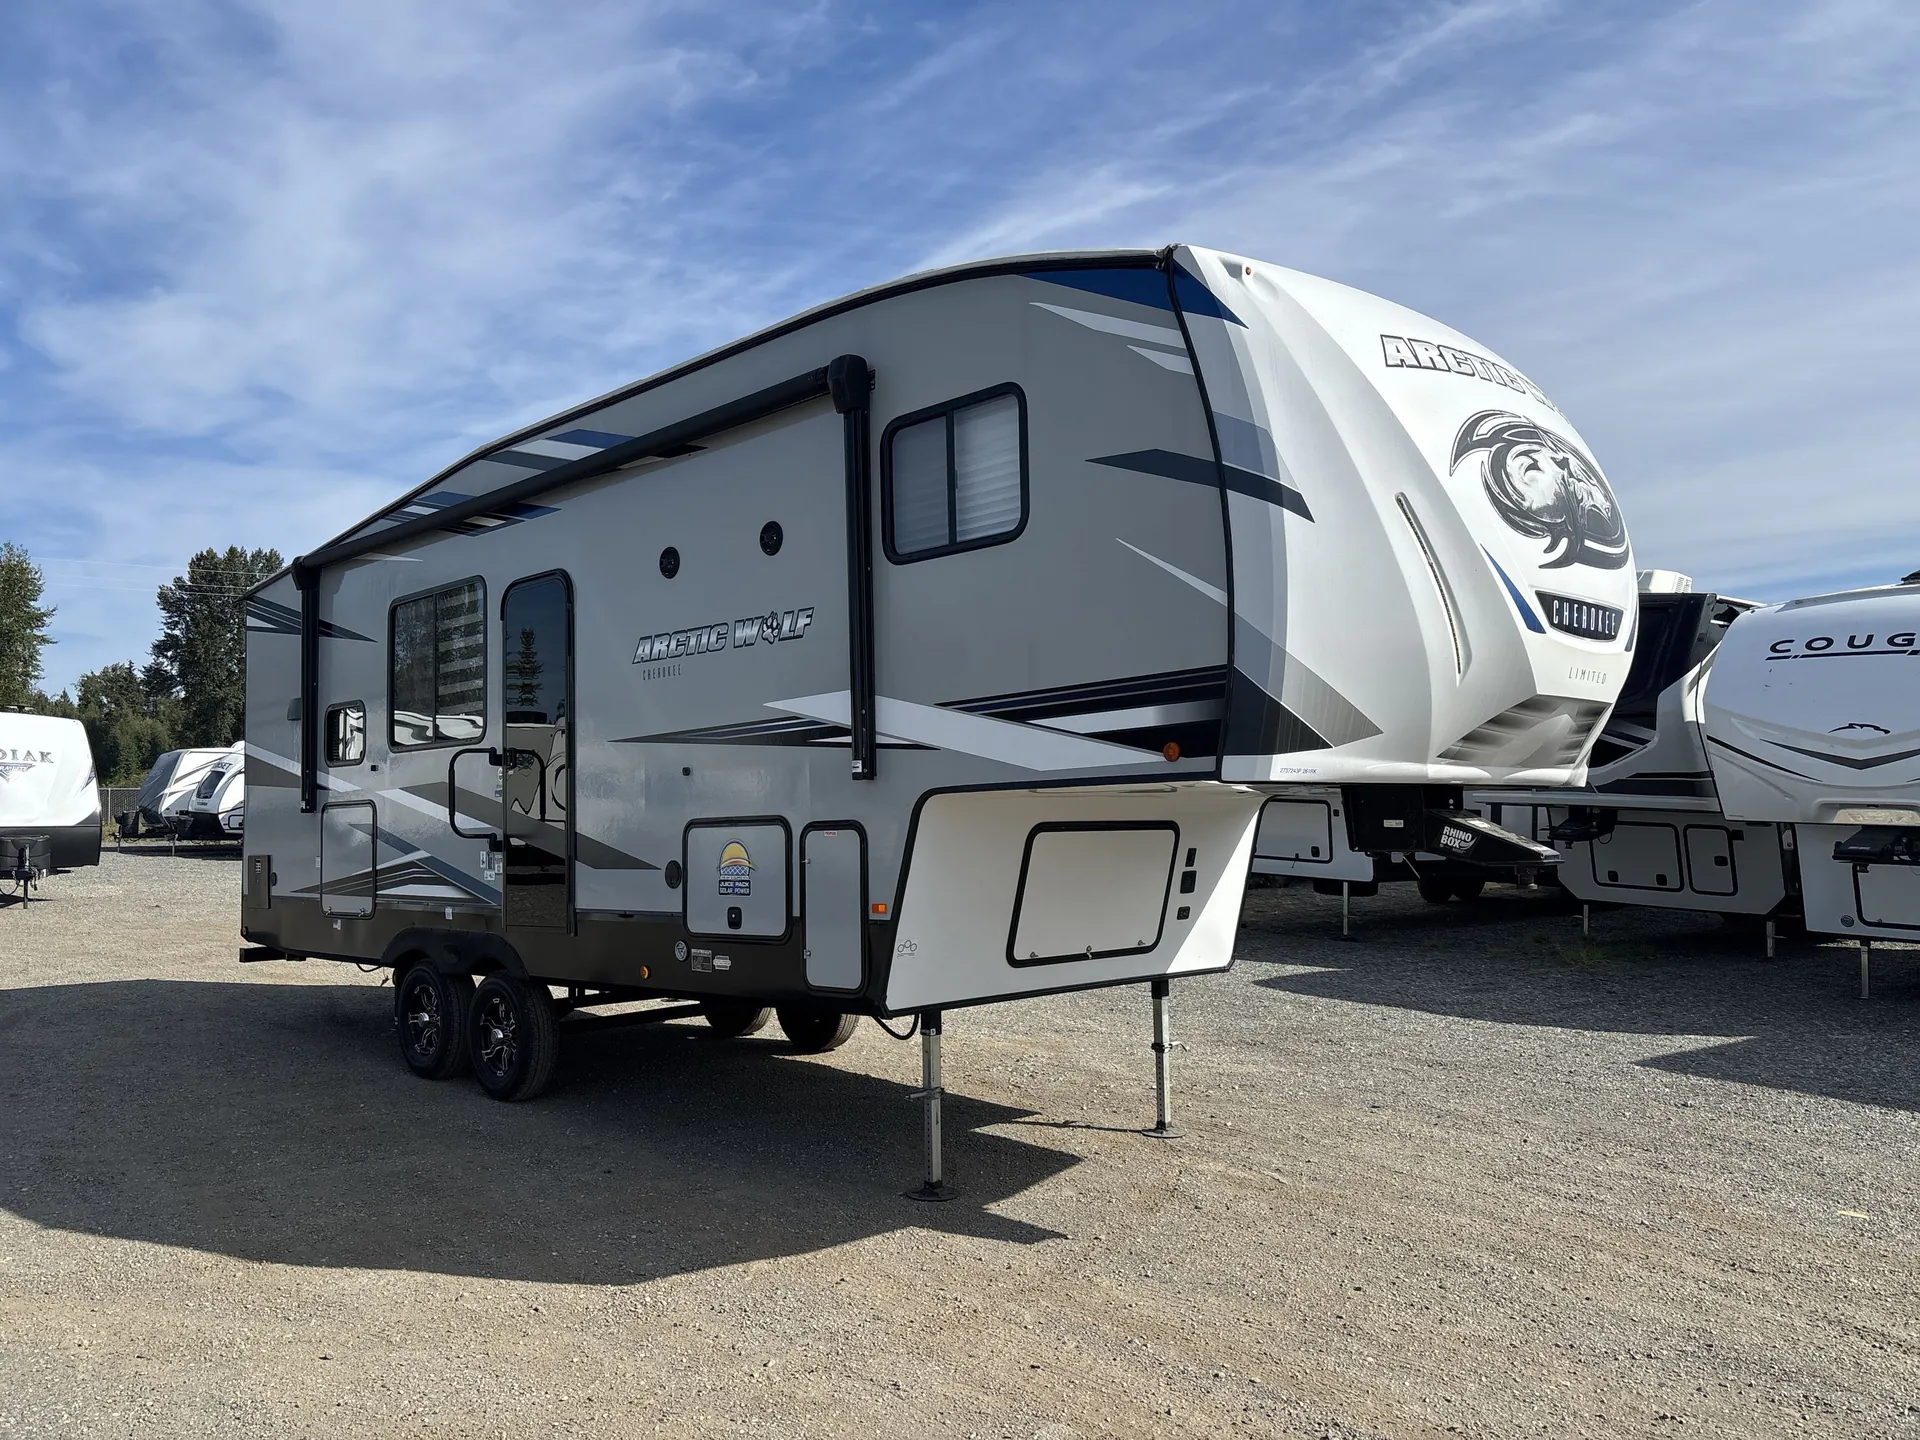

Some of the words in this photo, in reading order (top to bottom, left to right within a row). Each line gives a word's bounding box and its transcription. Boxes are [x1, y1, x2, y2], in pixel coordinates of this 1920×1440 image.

[1379, 333, 1526, 394] ARCTIC
[1552, 599, 1616, 636] CHEROKEE
[632, 622, 730, 664] ARCTIC
[1769, 632, 1917, 654] COUG
[642, 663, 682, 681] CHEROKEE
[1568, 666, 1607, 685] LIMITED
[1440, 834, 1461, 849] BOX
[1443, 825, 1472, 842] RHINO
